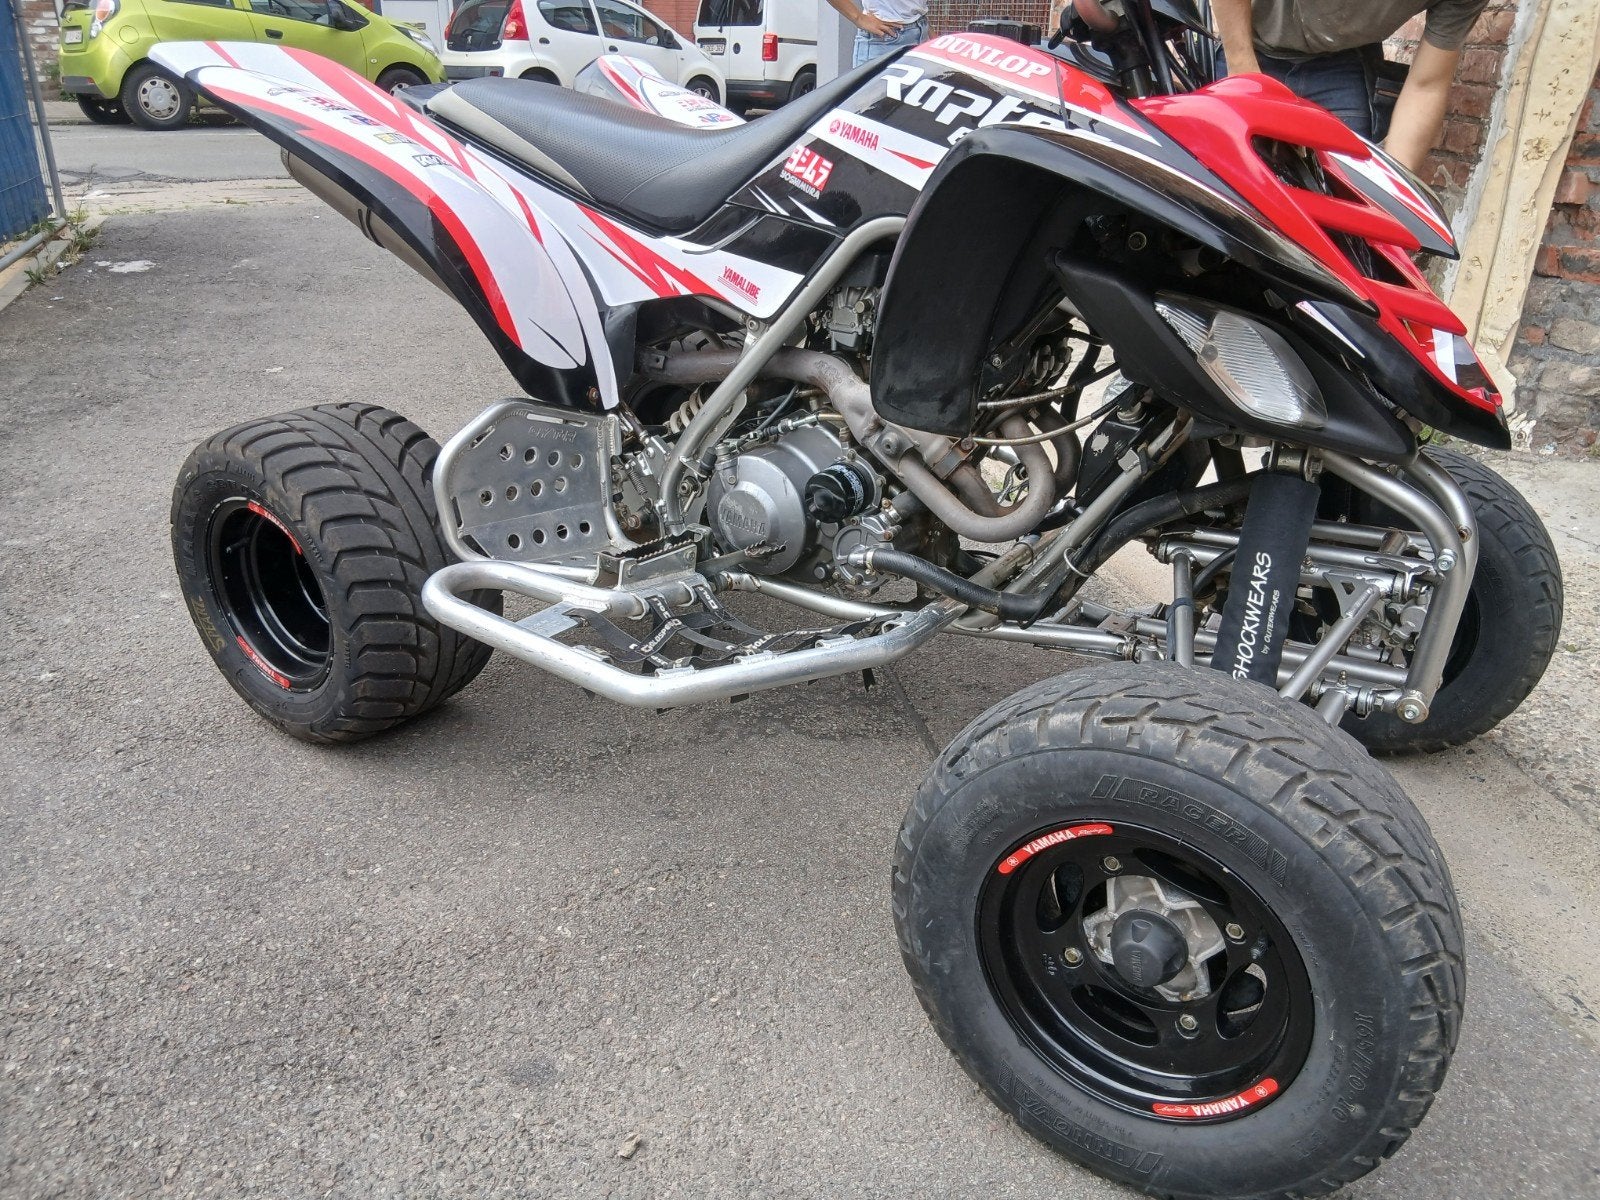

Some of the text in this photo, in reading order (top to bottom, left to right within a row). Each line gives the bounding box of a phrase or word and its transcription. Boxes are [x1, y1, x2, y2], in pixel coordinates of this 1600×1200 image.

[931, 35, 1052, 79] DUNLOP
[839, 123, 880, 151] YAMAHA
[779, 169, 821, 200] YOSHIMURA
[723, 265, 762, 300] YAMALUBE
[1232, 551, 1272, 682] SHOCKWEARS
[1261, 589, 1280, 655] by OUTERWEARS
[1138, 787, 1248, 845] RACER
[1022, 829, 1076, 855] YAMAHA
[1191, 1095, 1250, 1117] YAMAHA
